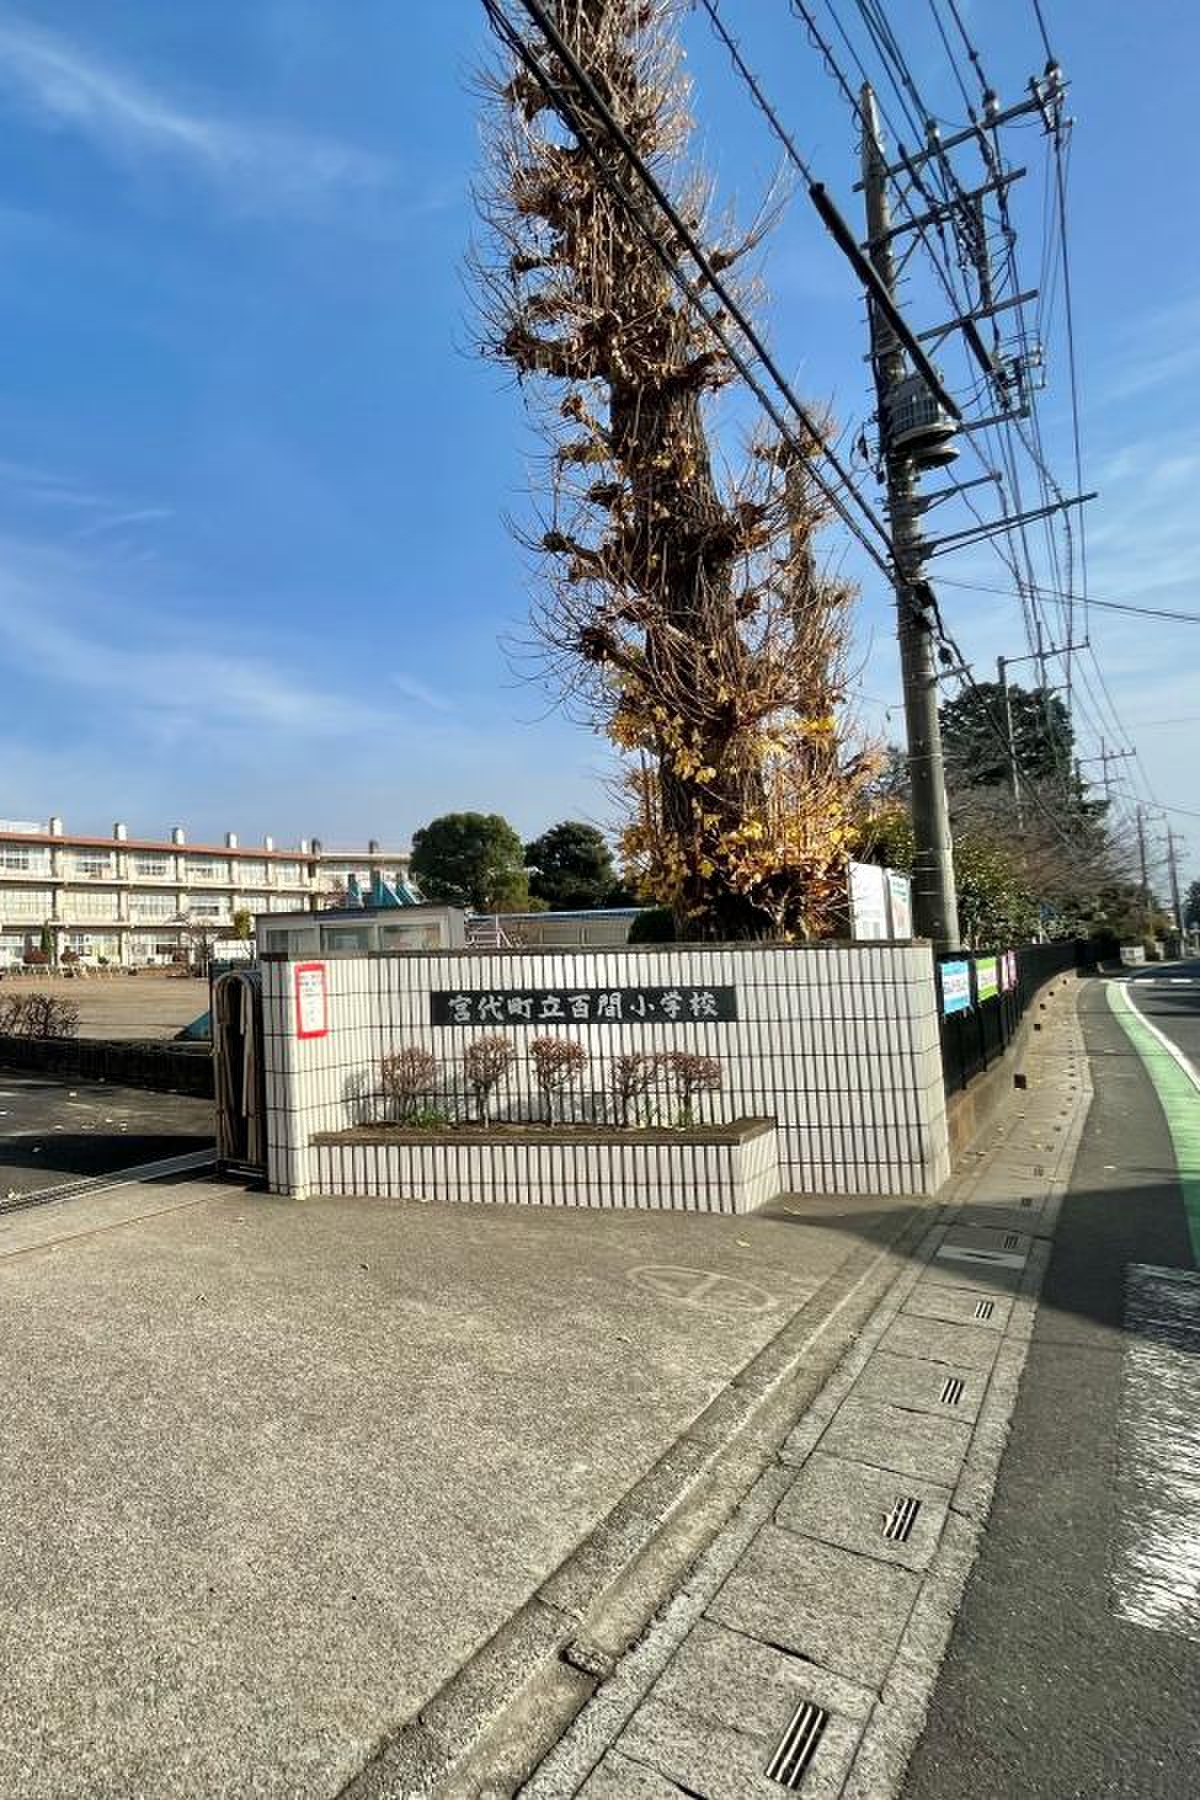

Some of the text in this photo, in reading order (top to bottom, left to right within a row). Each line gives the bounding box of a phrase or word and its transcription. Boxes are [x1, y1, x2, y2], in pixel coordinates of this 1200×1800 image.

[447, 989, 720, 1022] 宮代町立百間小学校
